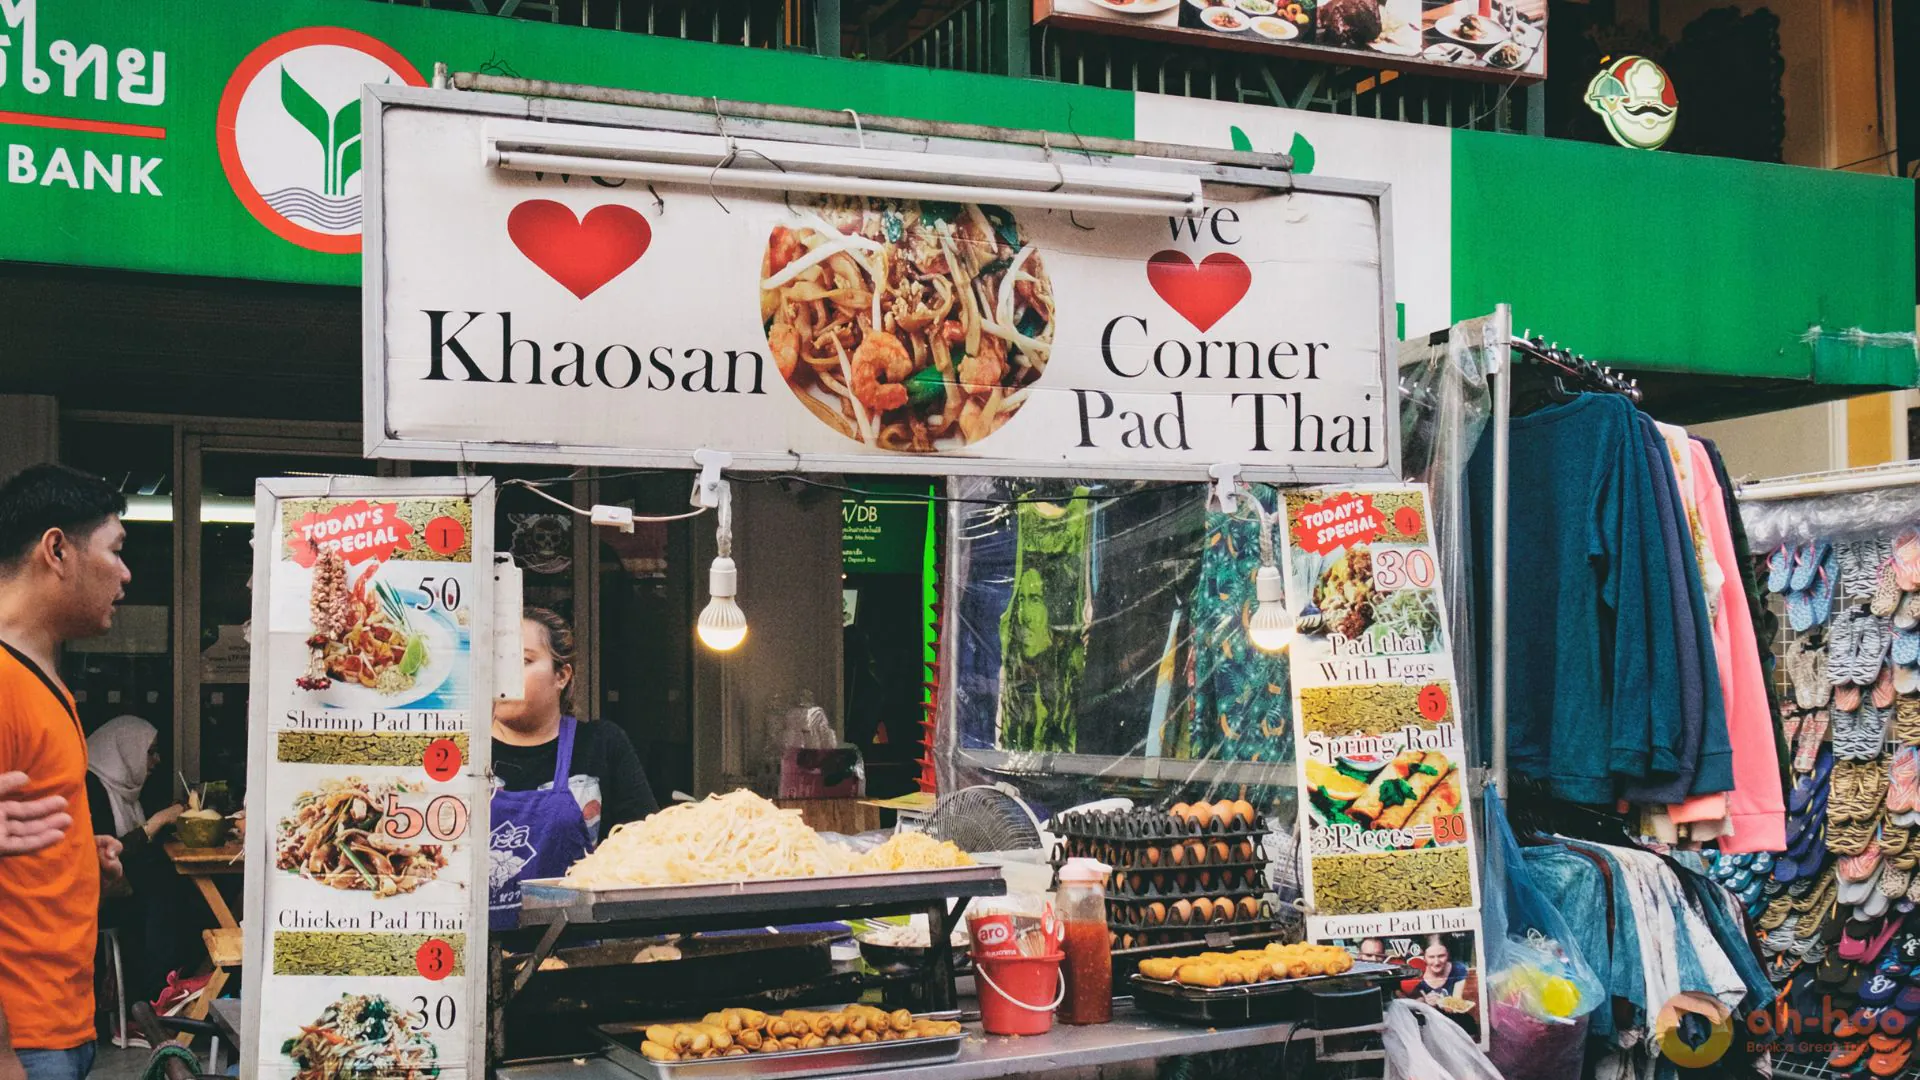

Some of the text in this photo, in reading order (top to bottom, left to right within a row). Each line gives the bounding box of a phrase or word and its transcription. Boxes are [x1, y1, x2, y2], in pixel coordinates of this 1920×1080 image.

[8, 143, 163, 196] BANK
[420, 310, 767, 394] Khaosan
[1101, 315, 1329, 380] Corner
[1070, 389, 1374, 453] Pad Thai
[301, 508, 384, 541] TODAY'S
[1303, 499, 1364, 530] TODAY'S
[442, 528, 448, 549] 1
[1317, 515, 1377, 545] SPECIAL
[1376, 549, 1435, 589] 30
[416, 577, 461, 612] 50
[1330, 630, 1424, 656] Pad thai
[1319, 658, 1436, 684] With Eggs
[1428, 692, 1439, 713] 5
[286, 710, 464, 732] Shrimp Pad Thai
[1309, 724, 1454, 763] Spring Roll
[435, 747, 449, 772] 2
[384, 794, 468, 841] 50
[1437, 815, 1465, 839] 30
[279, 910, 463, 931] Chicken Pad Thai
[1325, 913, 1466, 936] Corner Pad Thai
[979, 928, 1005, 942] aro
[1390, 938, 1422, 957] We
[429, 947, 443, 972] 3
[410, 995, 457, 1031] 30
